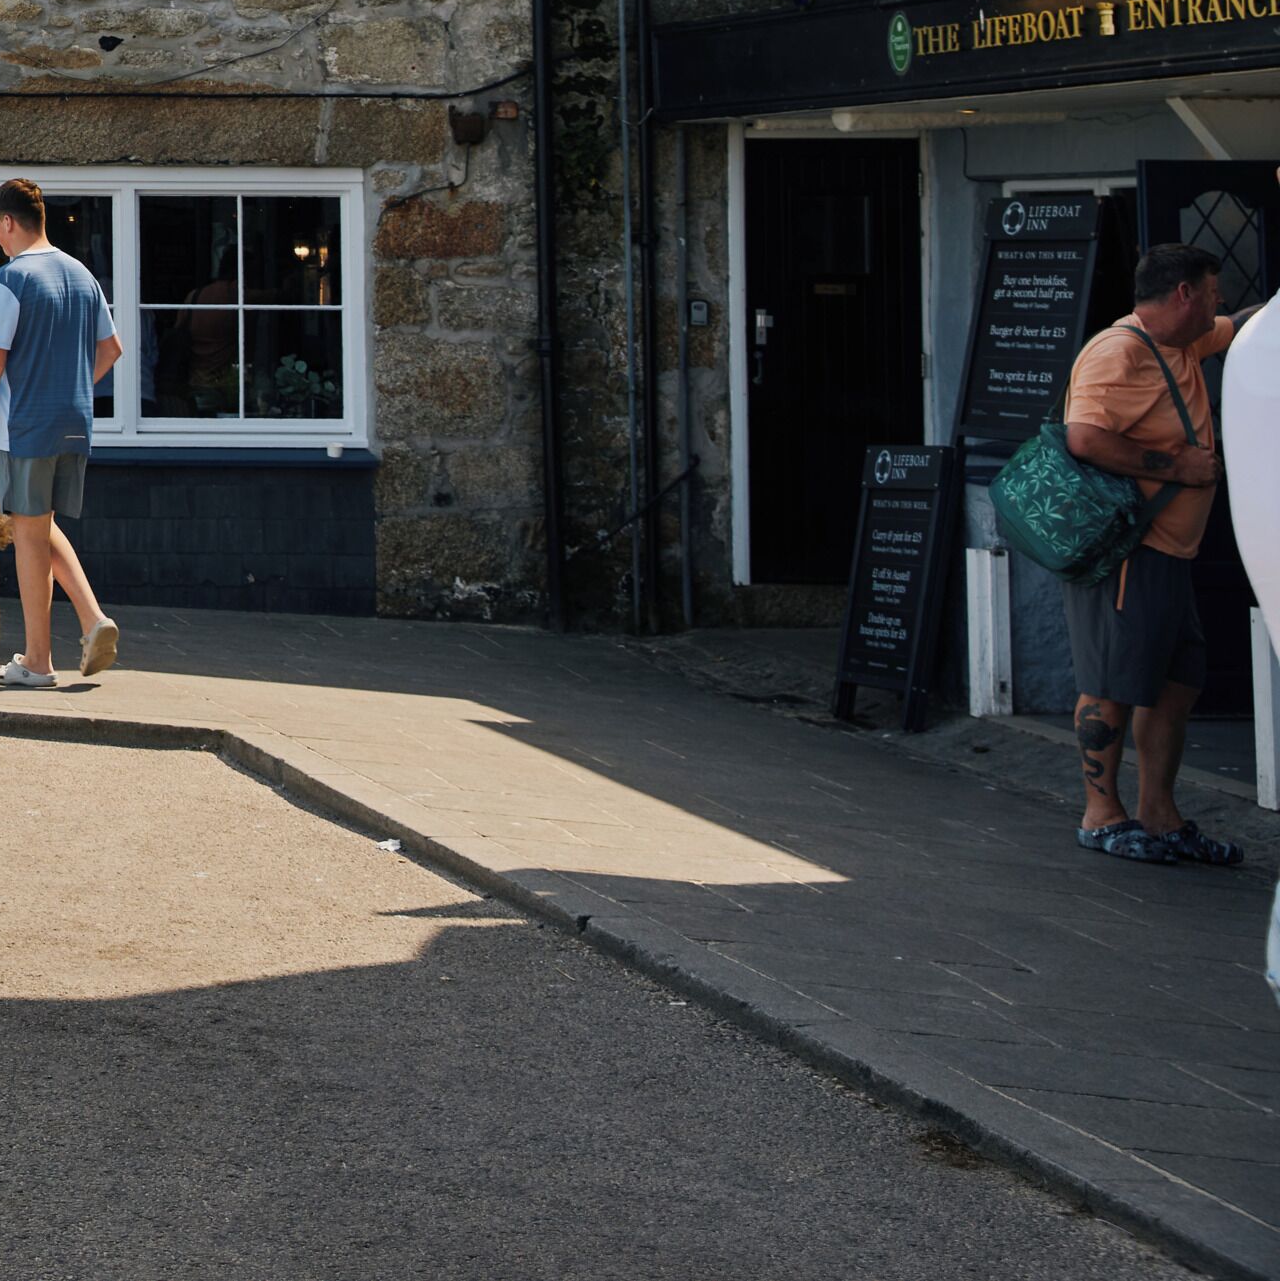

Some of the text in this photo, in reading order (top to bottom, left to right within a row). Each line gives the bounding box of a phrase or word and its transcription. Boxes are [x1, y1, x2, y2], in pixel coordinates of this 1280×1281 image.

[913, 22, 960, 56] THE
[972, 5, 1085, 50] LIFEBOAT
[1028, 205, 1082, 218] LIFEBOAT
[1026, 219, 1049, 231] INN
[997, 251, 1024, 260] WHAT'S
[1024, 251, 1036, 260] ON
[1038, 251, 1054, 260] THIS
[1002, 274, 1068, 288] Buy one breakfast,
[993, 288, 1006, 301] get
[1012, 288, 1038, 298] second
[1038, 288, 1054, 299] half
[1054, 289, 1074, 301] price
[989, 324, 1013, 339] Burger
[1014, 325, 1022, 336] &
[1022, 325, 1039, 337] beer
[1040, 325, 1052, 337] for
[989, 368, 1002, 380] Two
[1004, 371, 1025, 384] spritz
[1027, 370, 1039, 382] for
[893, 454, 931, 467] LIFEBOAT
[891, 467, 908, 480] INN
[871, 529, 888, 544] Curry
